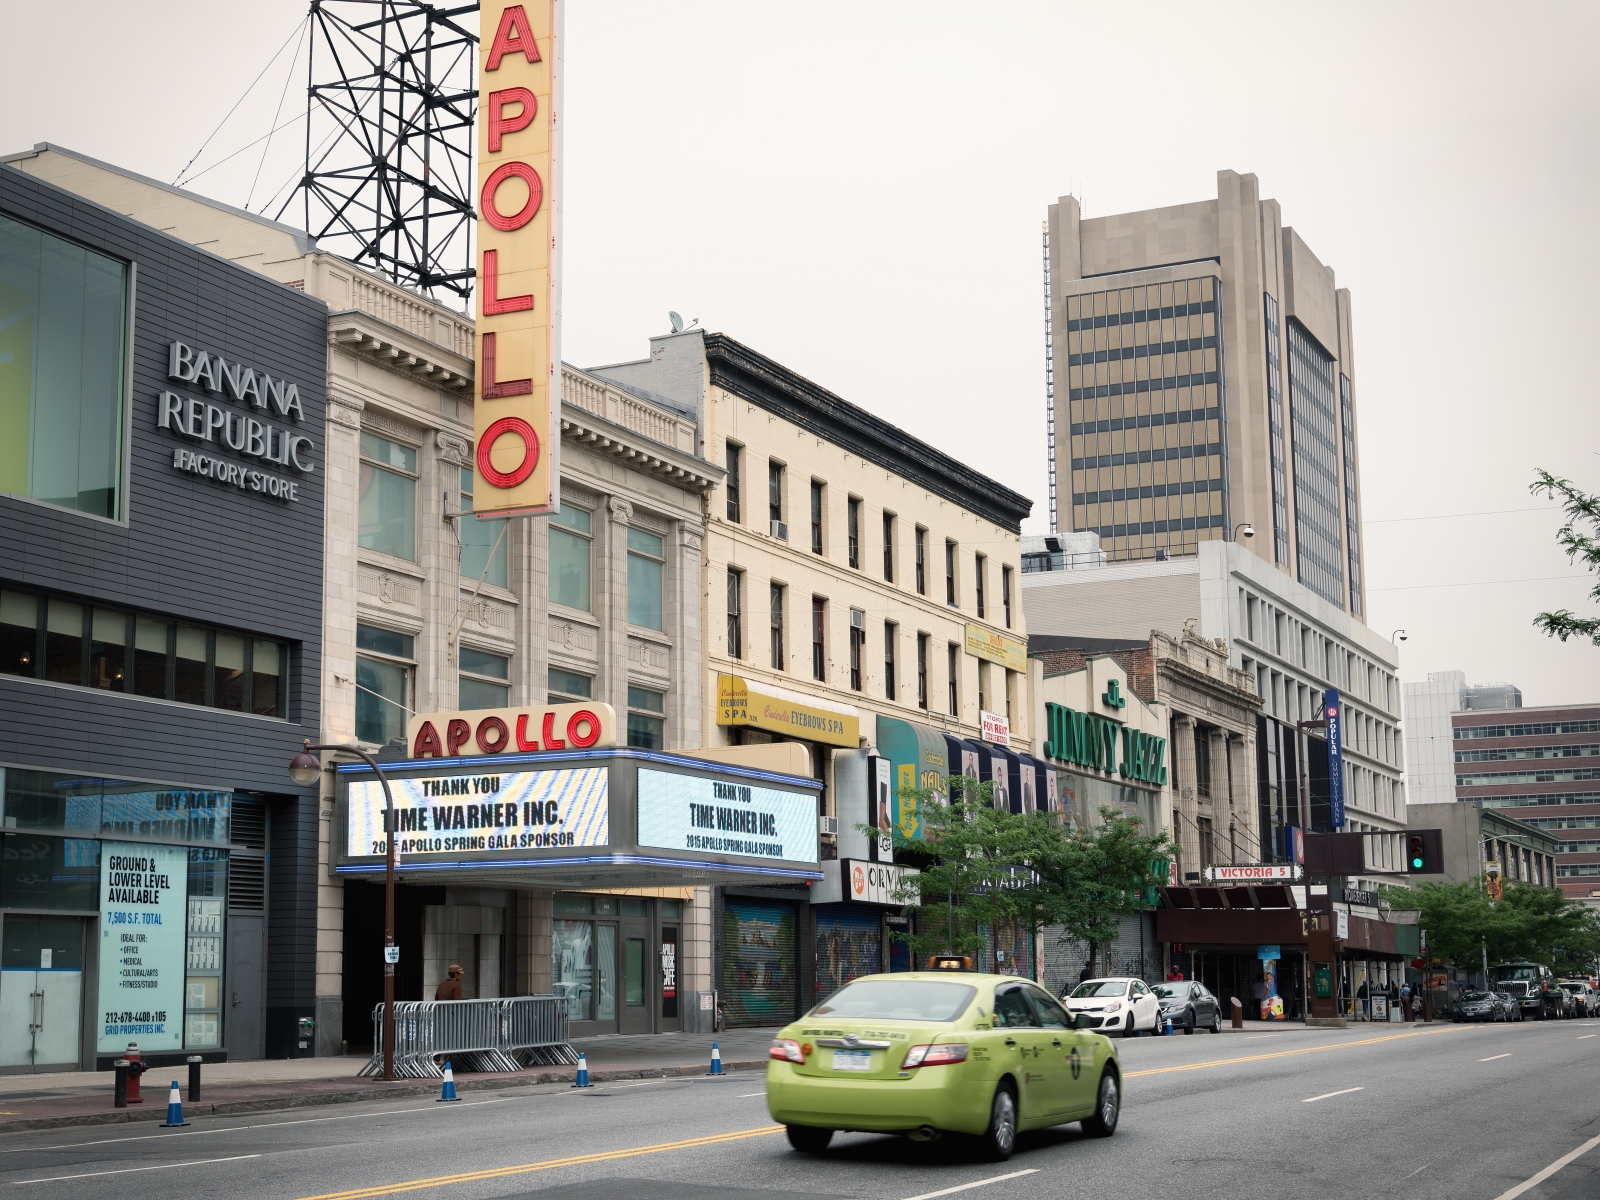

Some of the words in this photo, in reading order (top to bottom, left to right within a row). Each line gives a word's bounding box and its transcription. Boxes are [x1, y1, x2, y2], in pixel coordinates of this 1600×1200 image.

[477, 5, 543, 489] APOLLO
[169, 340, 305, 422] BANANA
[157, 390, 315, 472] REPUBLIC
[174, 448, 247, 489] FACTORY
[251, 470, 299, 502] STORE
[721, 689, 747, 697] Cinderella
[720, 699, 747, 707] EYEBROWS
[724, 709, 747, 718] SPA
[763, 704, 789, 723] Cinderella
[791, 710, 826, 732] EYEBROWS
[828, 719, 844, 735] SPA
[413, 709, 602, 759] APOLLO
[983, 720, 993, 732] FOR
[994, 723, 1008, 736] RENT
[1329, 718, 1338, 755] POPULAR
[1043, 702, 1121, 773] JIMMY
[1119, 727, 1167, 786] JAZZ
[422, 778, 469, 797] THANK
[473, 776, 500, 794] YOU
[920, 770, 948, 797] NAILS
[712, 782, 737, 801] THANK
[737, 786, 752, 803] YOU
[433, 802, 518, 831] WARNER
[523, 800, 564, 826] INC.
[690, 803, 715, 829] TIME
[716, 806, 757, 834] WARNER
[759, 812, 778, 837] INC.
[402, 838, 442, 853] APOLLO
[444, 835, 485, 851] SPRING
[488, 834, 518, 849] GALA
[519, 832, 574, 848] SPONSOR
[686, 834, 701, 849] 2015
[701, 835, 723, 851] APOLLO
[723, 838, 744, 853] SPRING
[744, 841, 759, 856] GALA
[758, 842, 783, 857] SPONSOR
[109, 856, 148, 872] GROUND
[149, 858, 156, 873] &
[1220, 867, 1273, 878] VICTORIA
[1279, 867, 1286, 876] 5
[109, 872, 142, 888] LOWER
[144, 873, 171, 889] LEVEL
[108, 888, 160, 905] AVAILABLE
[107, 911, 127, 926] 7,500
[127, 912, 141, 924] S.F.
[142, 912, 163, 925] TOTAL
[120, 933, 135, 943] IDEAL
[136, 933, 148, 943] FOR:
[123, 945, 139, 954] OFFICE
[123, 957, 143, 966] MEDICAL
[122, 968, 159, 978] CULTURAL/ARTS
[122, 980, 158, 989] FITNESS/STUDIO
[105, 1011, 151, 1024] 212-678-4400
[151, 1011, 167, 1022] x105
[105, 1025, 119, 1035] GRID
[119, 1024, 154, 1035] PROPERTIES
[154, 1023, 166, 1034] INC.
